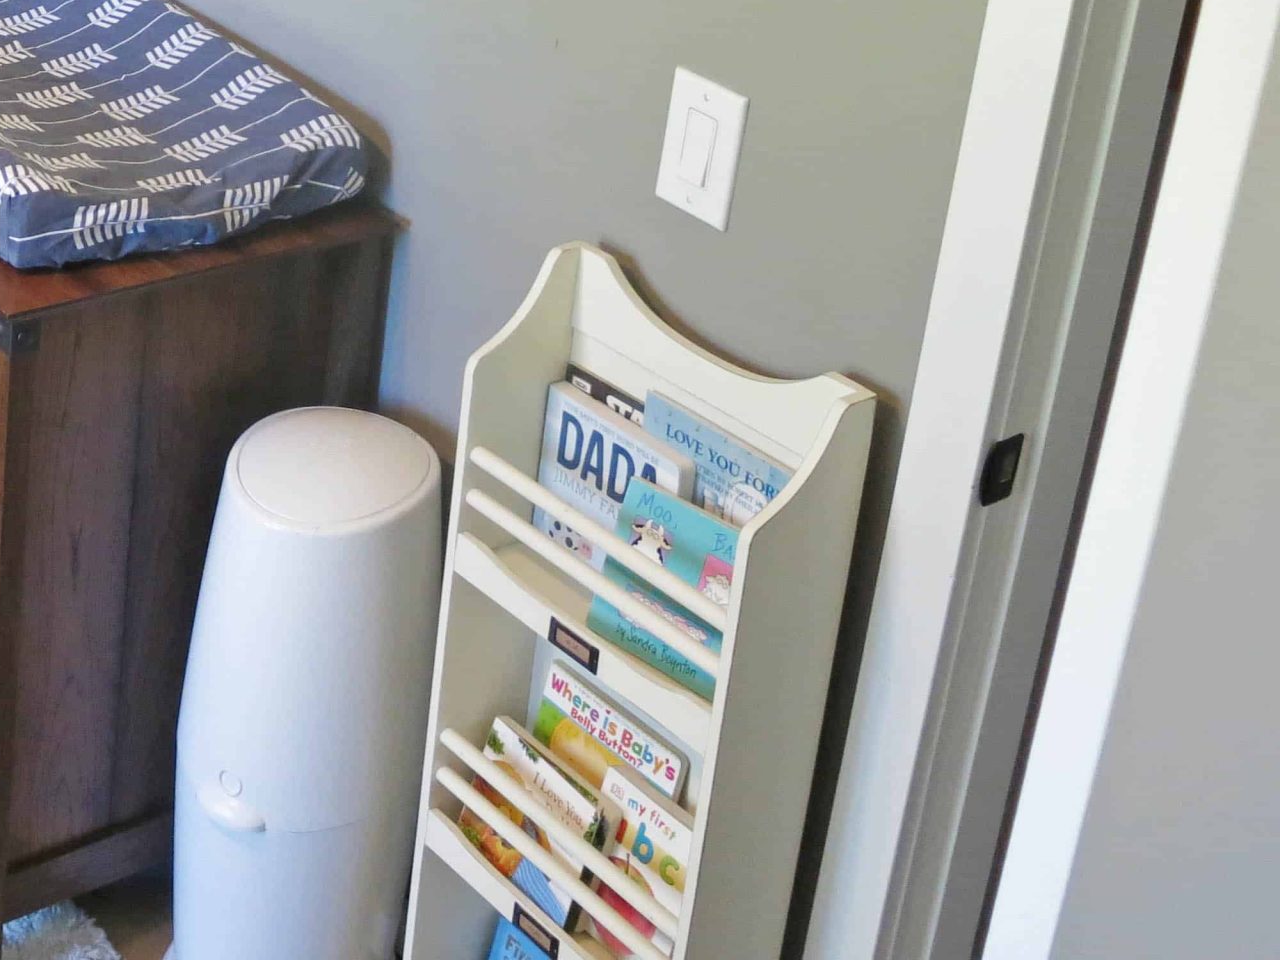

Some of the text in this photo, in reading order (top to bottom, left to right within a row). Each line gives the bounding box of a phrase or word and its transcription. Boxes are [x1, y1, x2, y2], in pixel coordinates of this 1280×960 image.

[666, 424, 705, 456] LOVE
[708, 448, 741, 477] YOU
[553, 466, 597, 504] JIMMY
[627, 626, 657, 655] Sandra
[660, 644, 697, 678] Boynton
[551, 673, 600, 723] Where
[603, 709, 619, 737] is
[620, 728, 676, 781] Baby's
[570, 707, 644, 769] Belly Button?
[533, 772, 540, 784] I
[540, 778, 564, 808] Love
[627, 797, 677, 840] my first
